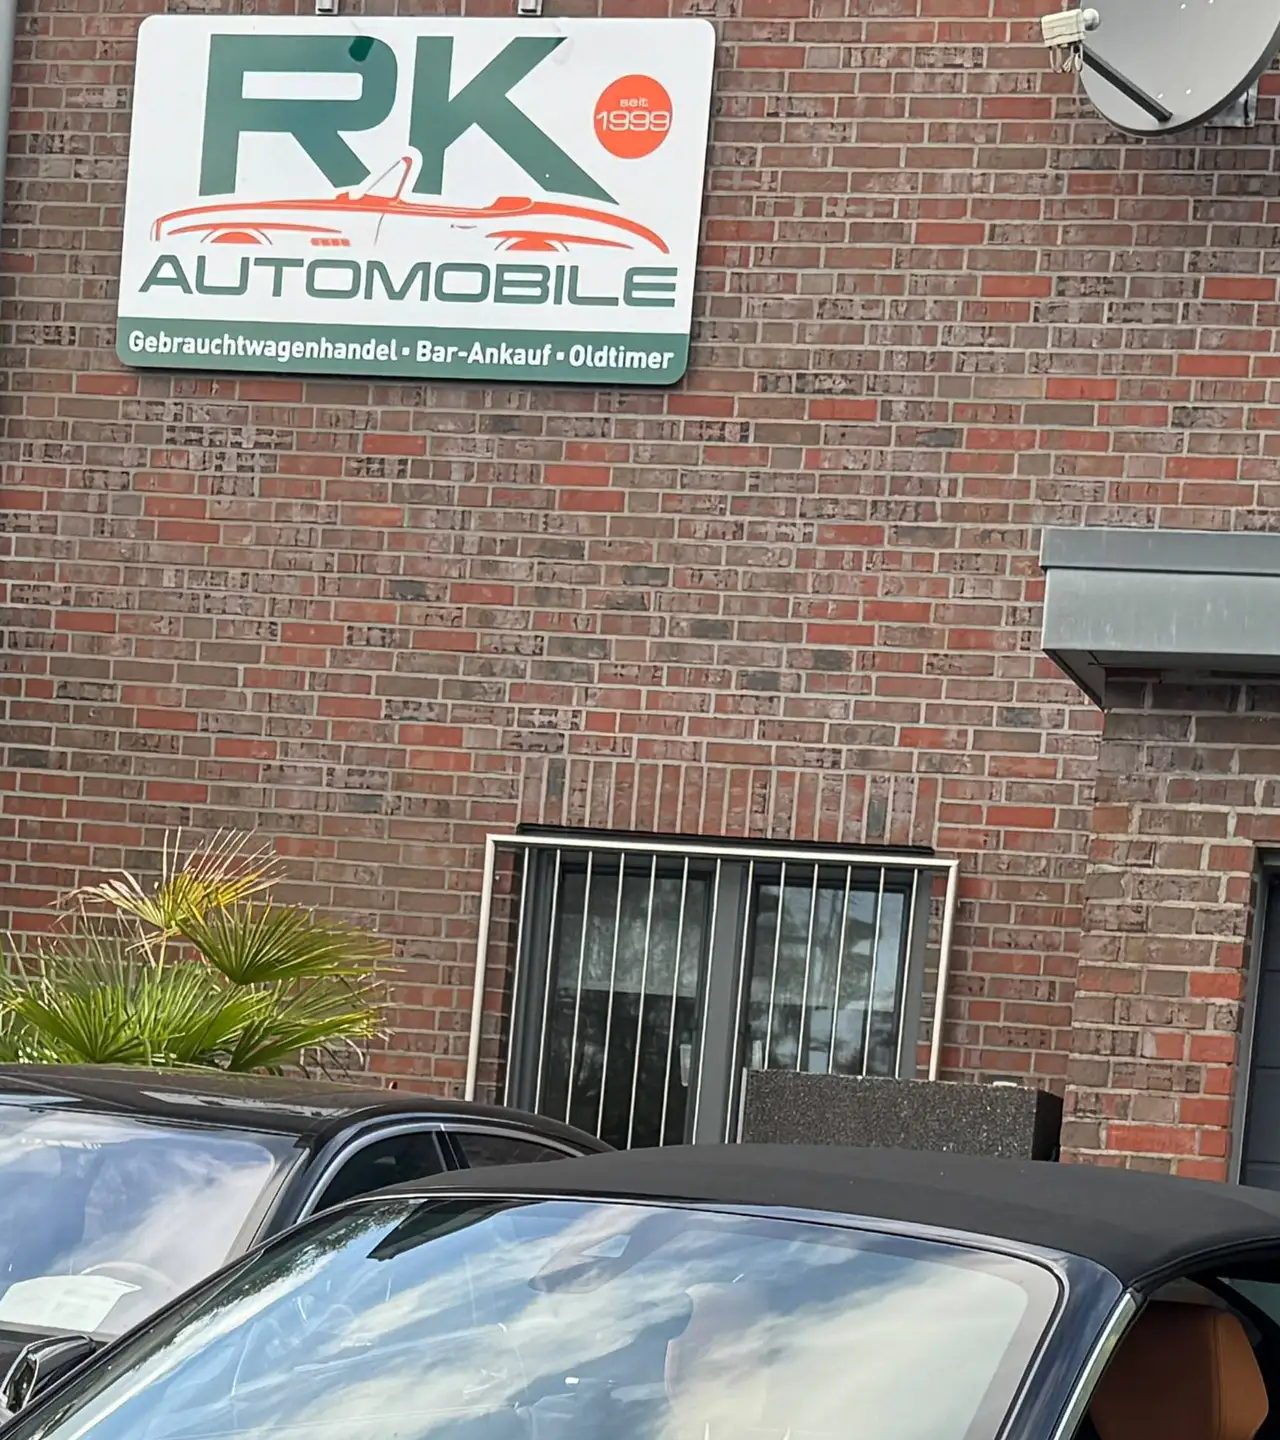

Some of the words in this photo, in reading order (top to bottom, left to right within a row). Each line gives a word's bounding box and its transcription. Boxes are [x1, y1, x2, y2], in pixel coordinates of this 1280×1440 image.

[199, 33, 620, 206] RK
[596, 110, 670, 132] 1999
[620, 97, 649, 108] seit
[138, 254, 678, 308] AUTOMOBILE
[128, 331, 397, 362] Gebrauchtwagenhandel
[416, 340, 552, 368] Bar-Ankauf
[569, 344, 674, 371] Oldtimer
